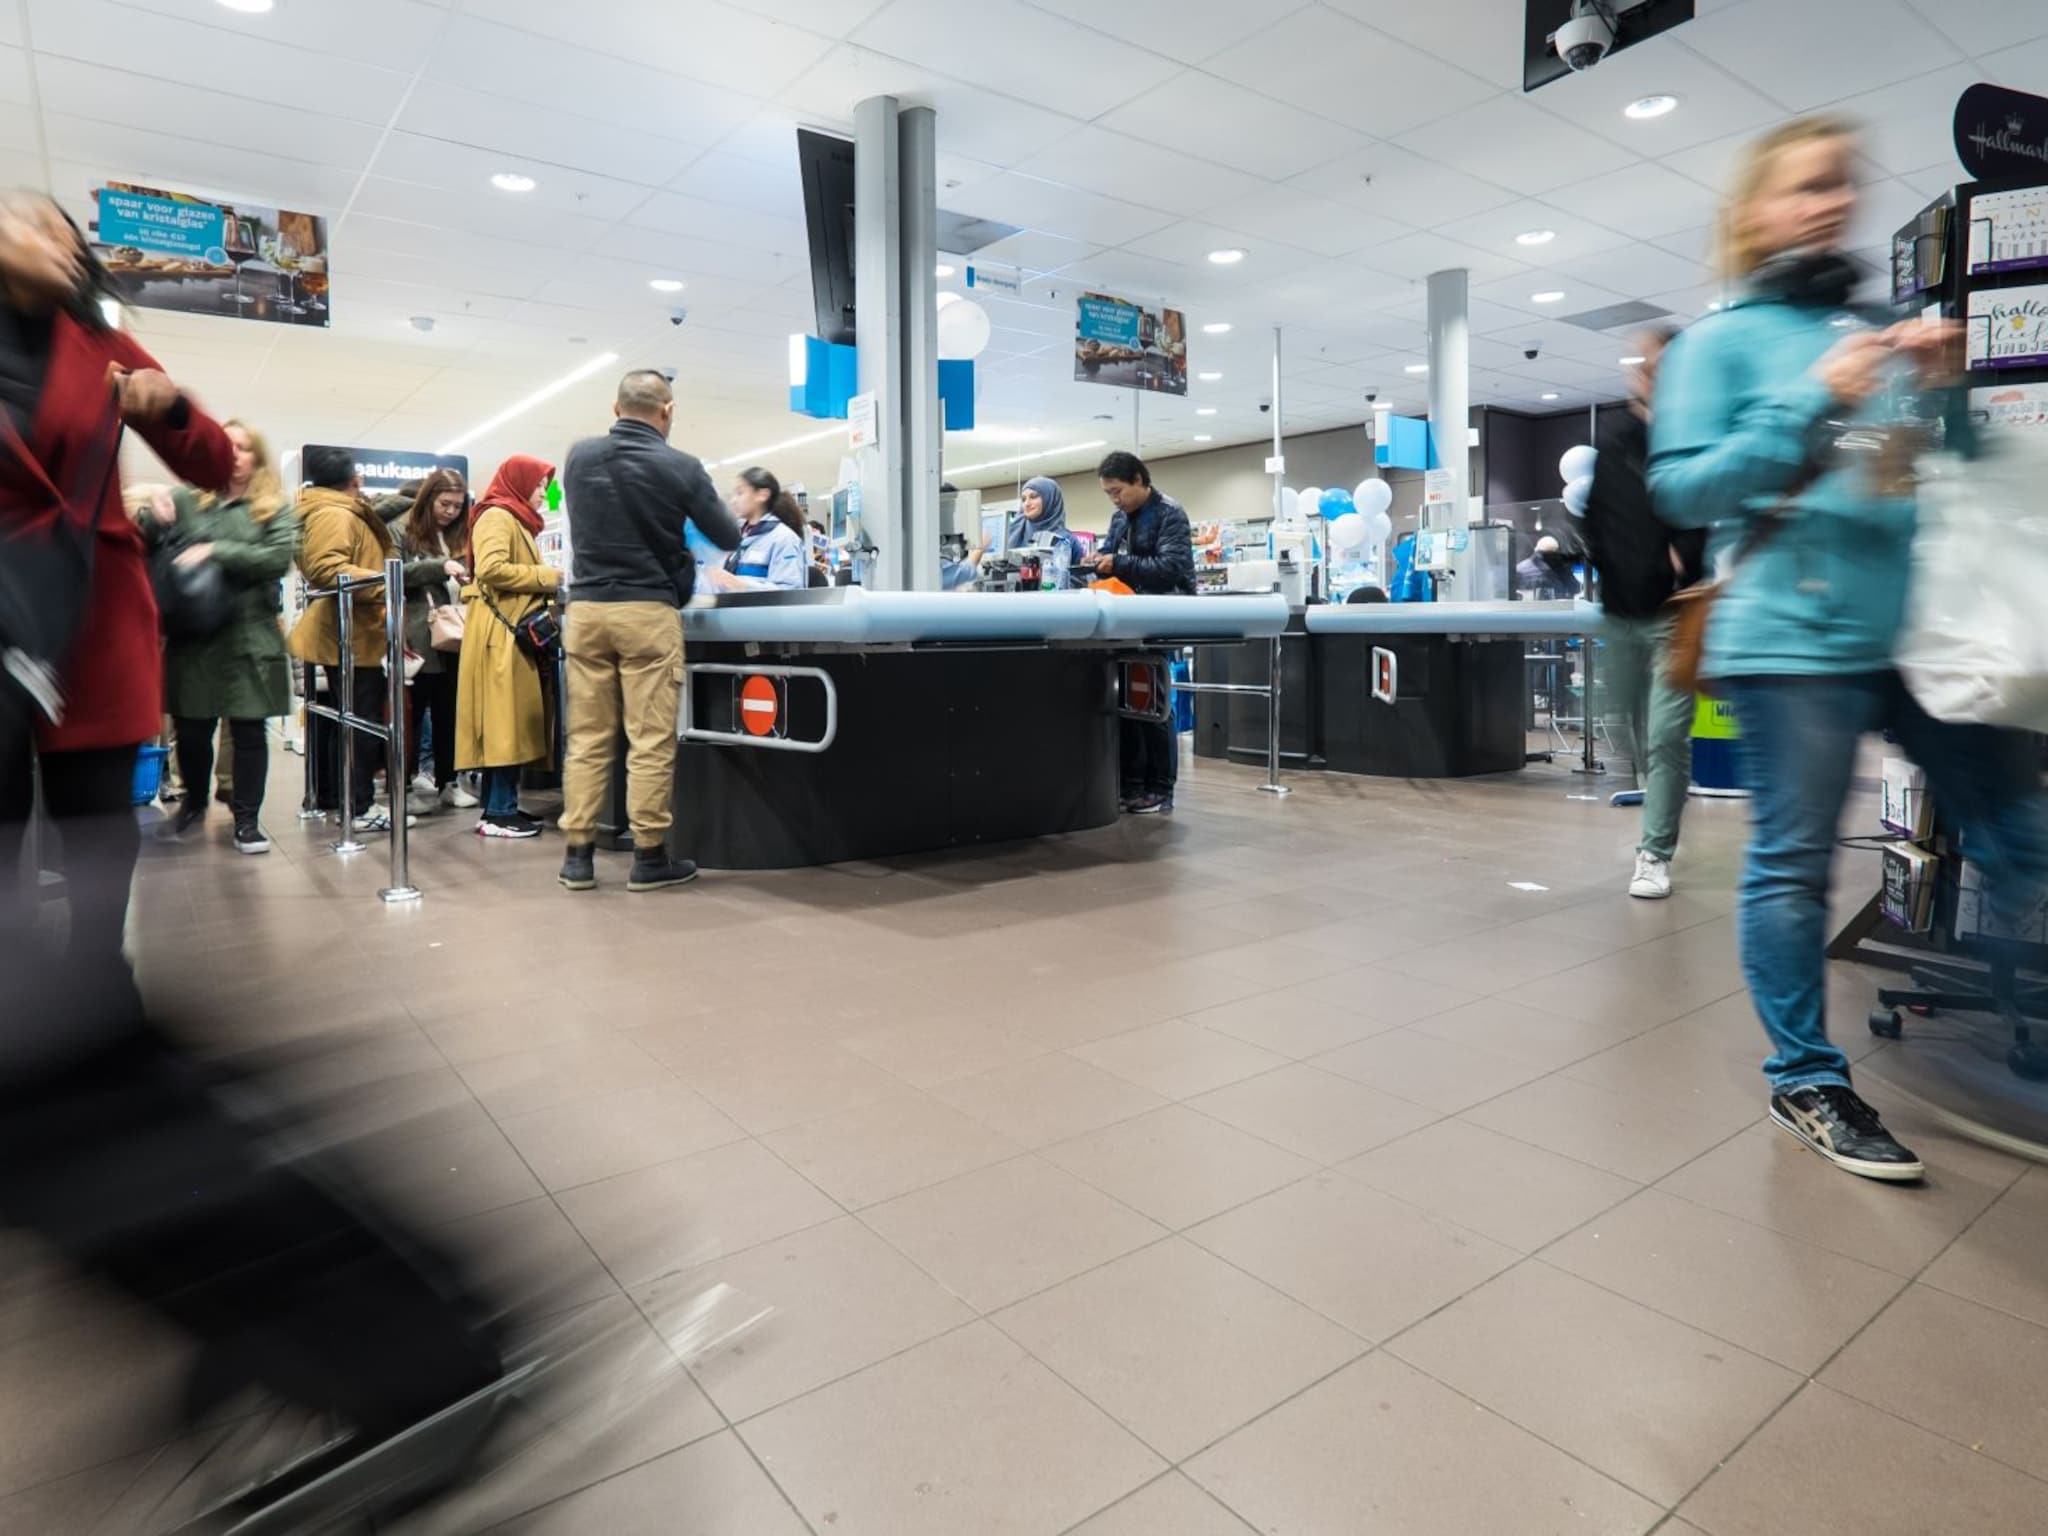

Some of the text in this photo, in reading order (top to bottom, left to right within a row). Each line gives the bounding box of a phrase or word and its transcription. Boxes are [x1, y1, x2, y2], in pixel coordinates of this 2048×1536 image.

[109, 196, 216, 221] spaar voor glazen
[117, 208, 138, 218] van
